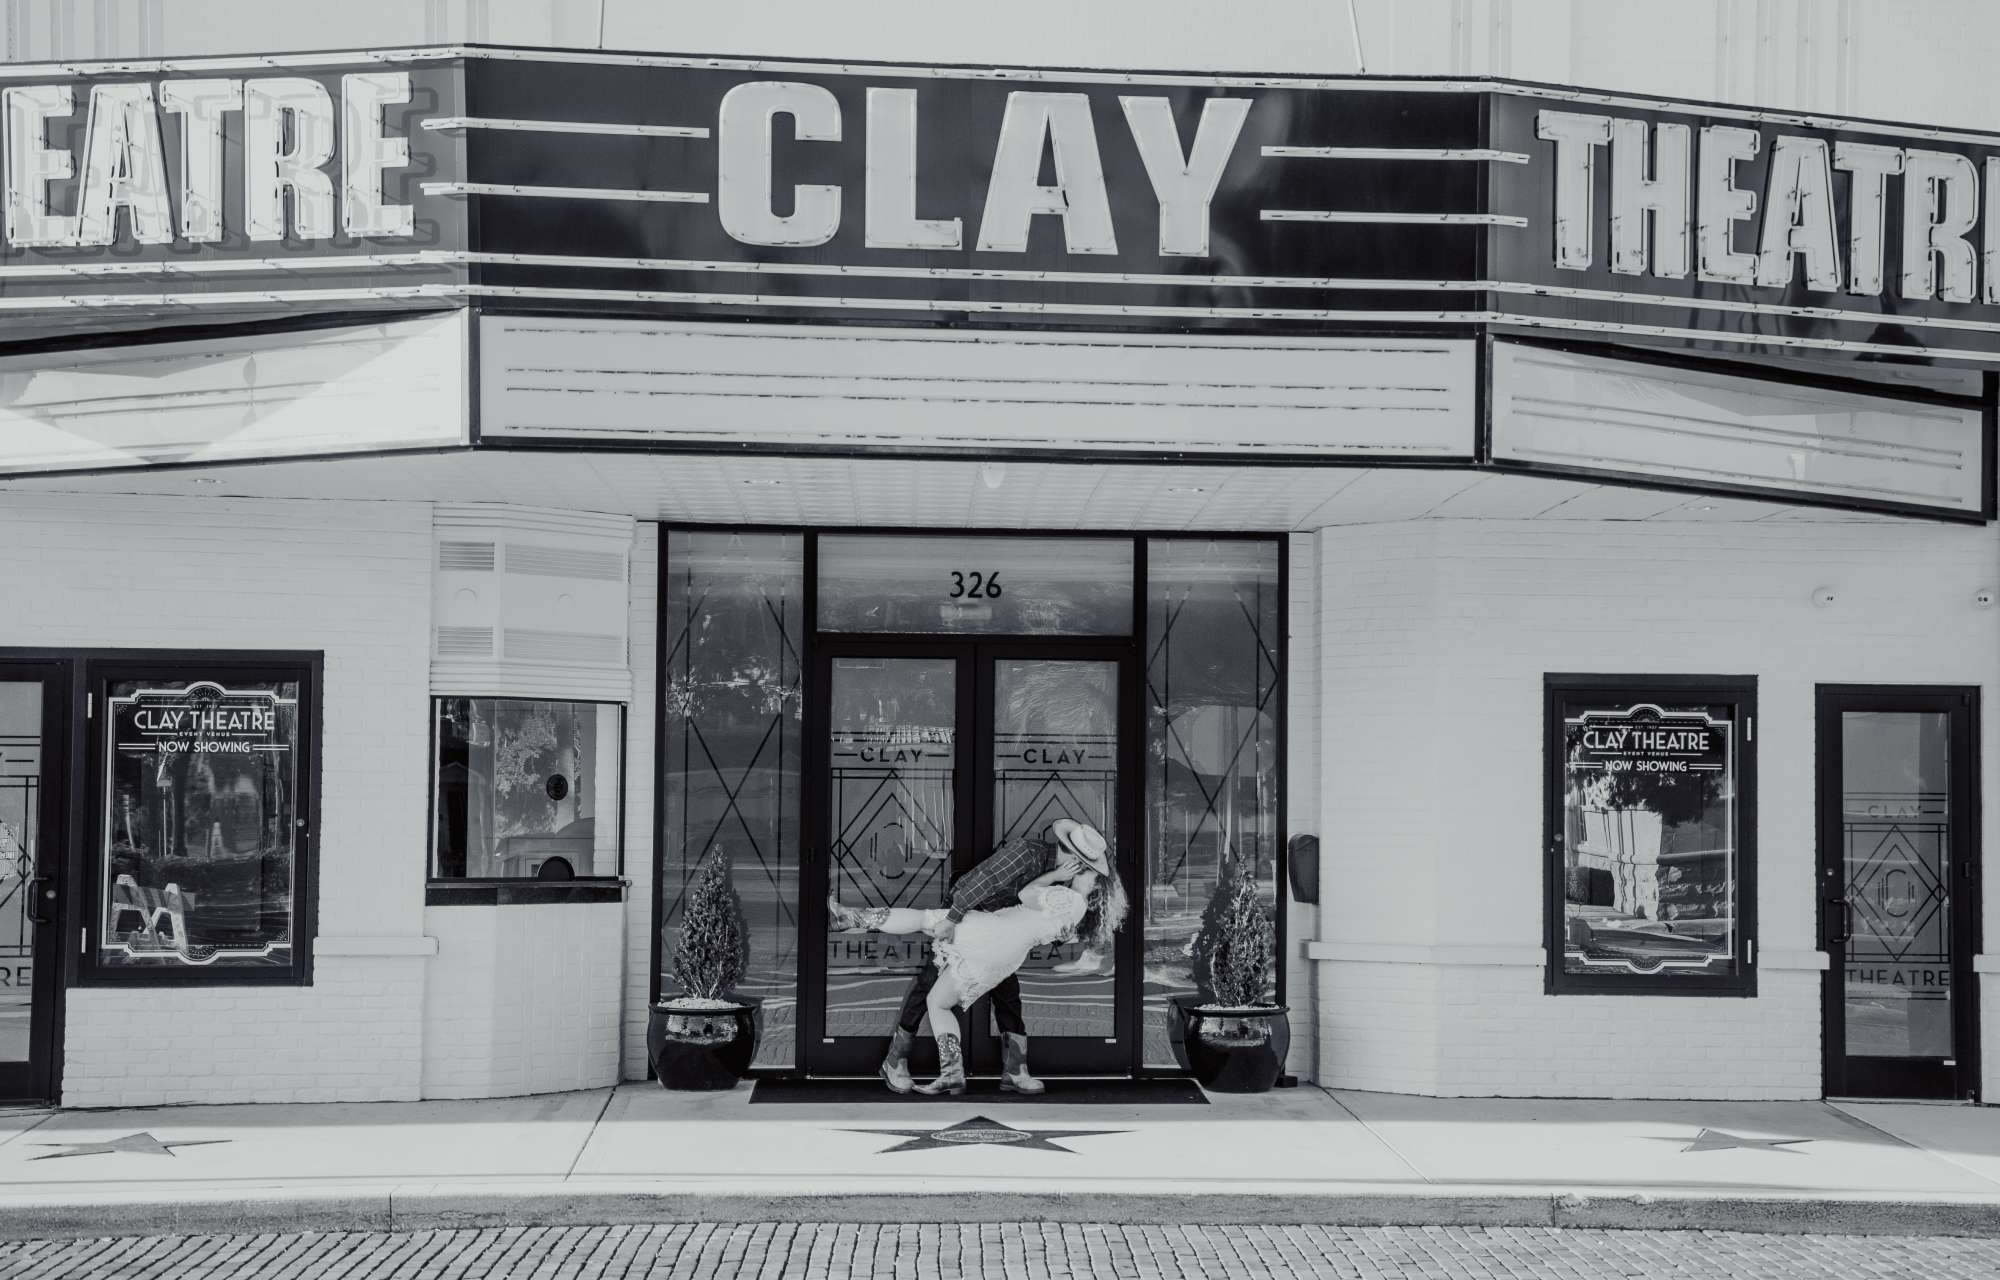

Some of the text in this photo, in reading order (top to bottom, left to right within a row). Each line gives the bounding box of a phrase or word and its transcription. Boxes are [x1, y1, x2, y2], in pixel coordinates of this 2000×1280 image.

[2, 71, 414, 247] EATRE
[718, 81, 1254, 258] CLAY
[1536, 109, 2000, 305] THEATR
[949, 571, 1002, 599] 326
[134, 711, 276, 731] CLAY THEATRE
[158, 741, 250, 753] NOW SHOWING
[1583, 731, 1710, 750] CLAY THEATRE
[860, 747, 922, 763] CLAY
[1023, 748, 1086, 764] CLAY
[1605, 760, 1688, 772] NOW SHOWING
[1867, 804, 1922, 819] CLAY
[1845, 969, 1950, 986] THEATRE
